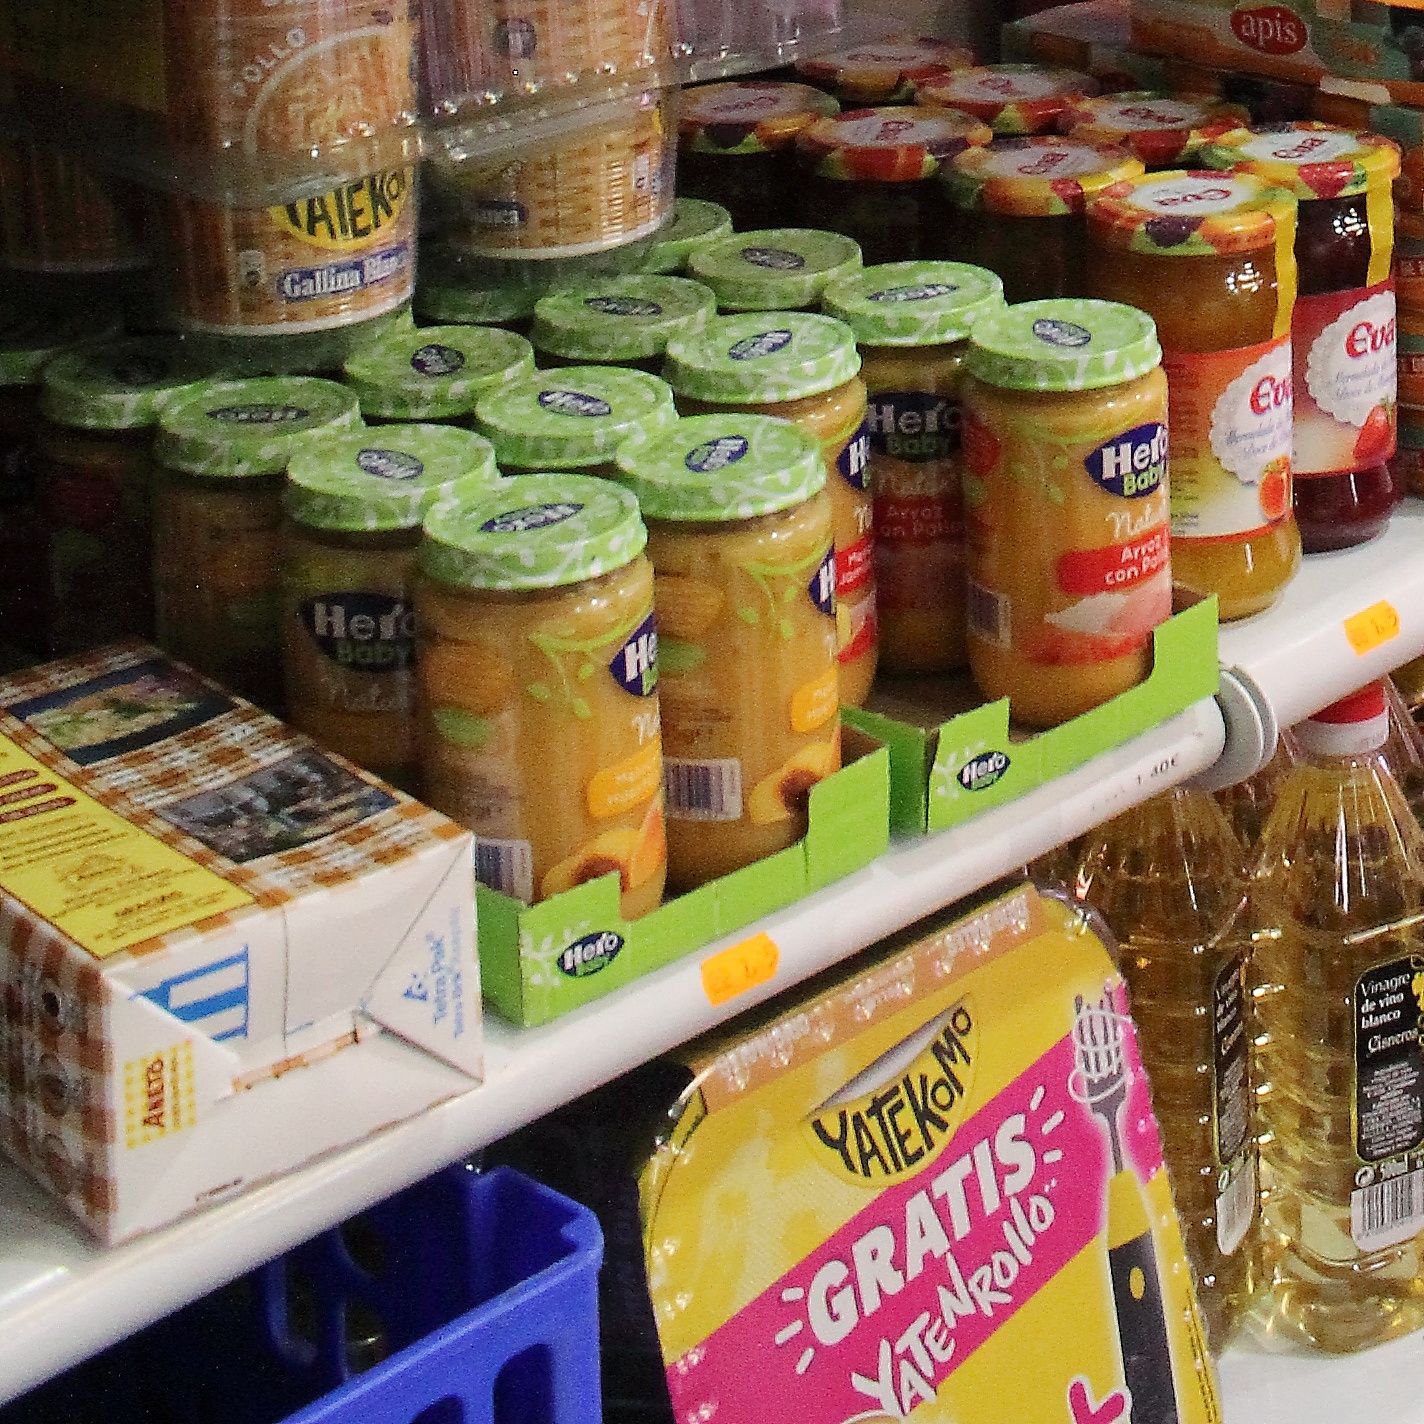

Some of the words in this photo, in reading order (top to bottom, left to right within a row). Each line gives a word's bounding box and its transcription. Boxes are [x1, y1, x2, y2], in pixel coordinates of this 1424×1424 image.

[1238, 11, 1299, 46] apis
[282, 263, 360, 299] Gallina
[1345, 321, 1396, 357] Eva
[1119, 537, 1162, 564] Arroz
[1104, 563, 1138, 586] con
[961, 751, 1009, 780] Hero
[563, 933, 618, 974] Hero
[1361, 973, 1410, 997] Vinagre
[1361, 1000, 1376, 1013] de
[1379, 992, 1404, 1008] vino
[1362, 1010, 1401, 1029] blanco
[1368, 1028, 1419, 1053] Cisneros
[811, 1002, 974, 1180] YATEKOMO
[806, 1115, 1037, 1348] GRATIS
